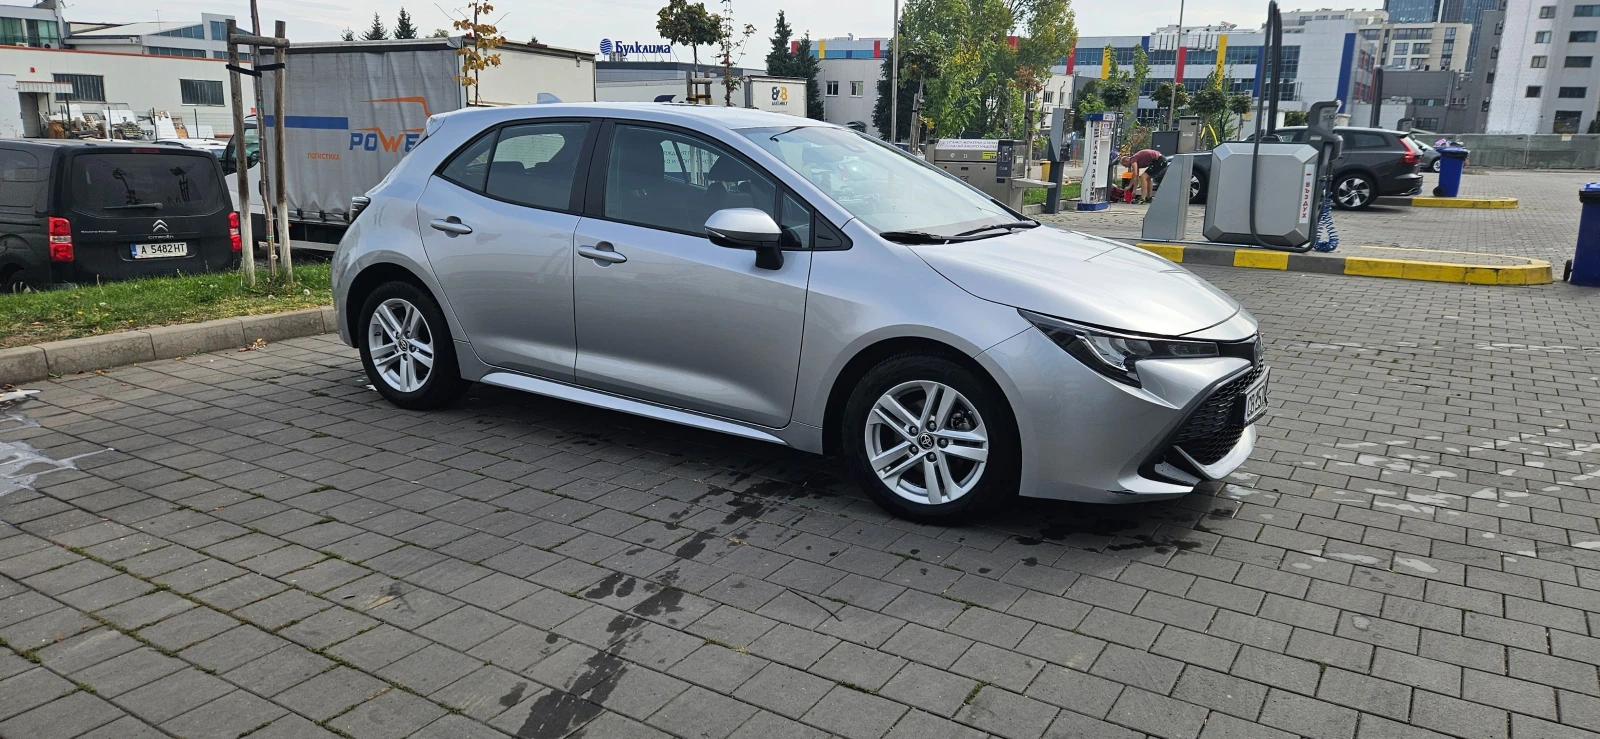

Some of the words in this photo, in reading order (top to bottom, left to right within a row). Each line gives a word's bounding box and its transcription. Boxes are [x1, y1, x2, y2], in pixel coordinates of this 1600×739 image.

[615, 41, 671, 57] Булклима
[1301, 181, 1311, 219] ВЪЗДУХ
[141, 245, 147, 254] A
